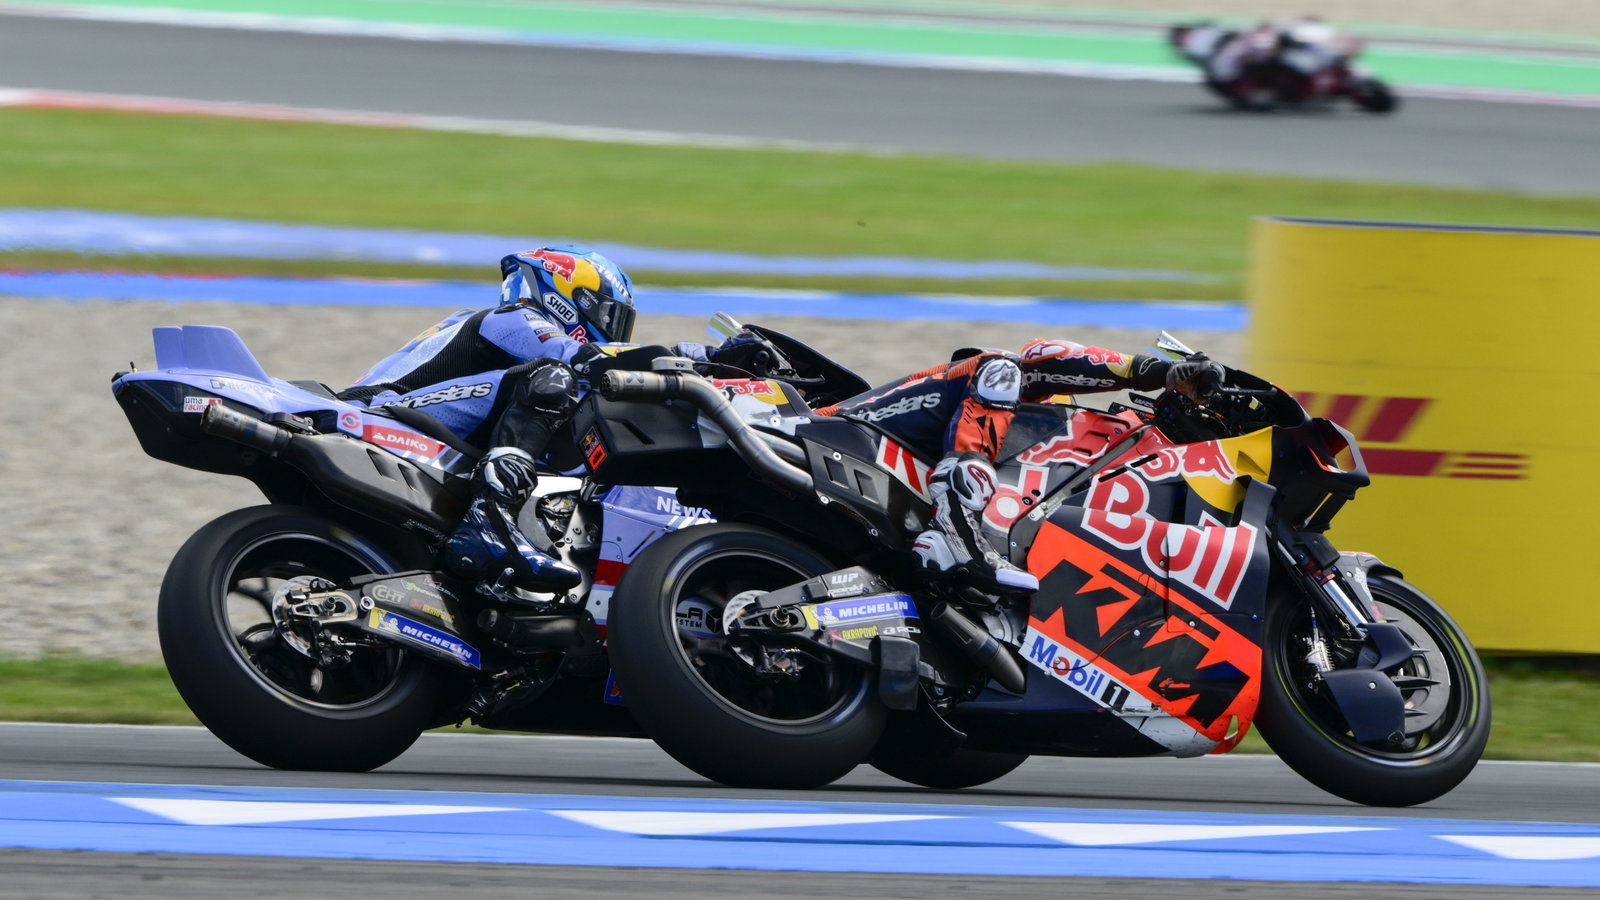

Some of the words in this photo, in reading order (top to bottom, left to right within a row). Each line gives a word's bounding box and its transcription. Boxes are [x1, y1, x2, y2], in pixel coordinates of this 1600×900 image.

[547, 295, 575, 322] SHOEI
[569, 325, 589, 344] Re
[1021, 369, 1116, 389] pinestars
[387, 434, 428, 451] DAIKO
[656, 495, 712, 519] NEWS
[1082, 469, 1256, 609] Bull
[838, 601, 909, 618] MICHELIN
[676, 618, 702, 628] STEM
[402, 625, 472, 659] MICHELIN
[1028, 558, 1250, 729] KTM
[1029, 635, 1105, 696] Mobil
